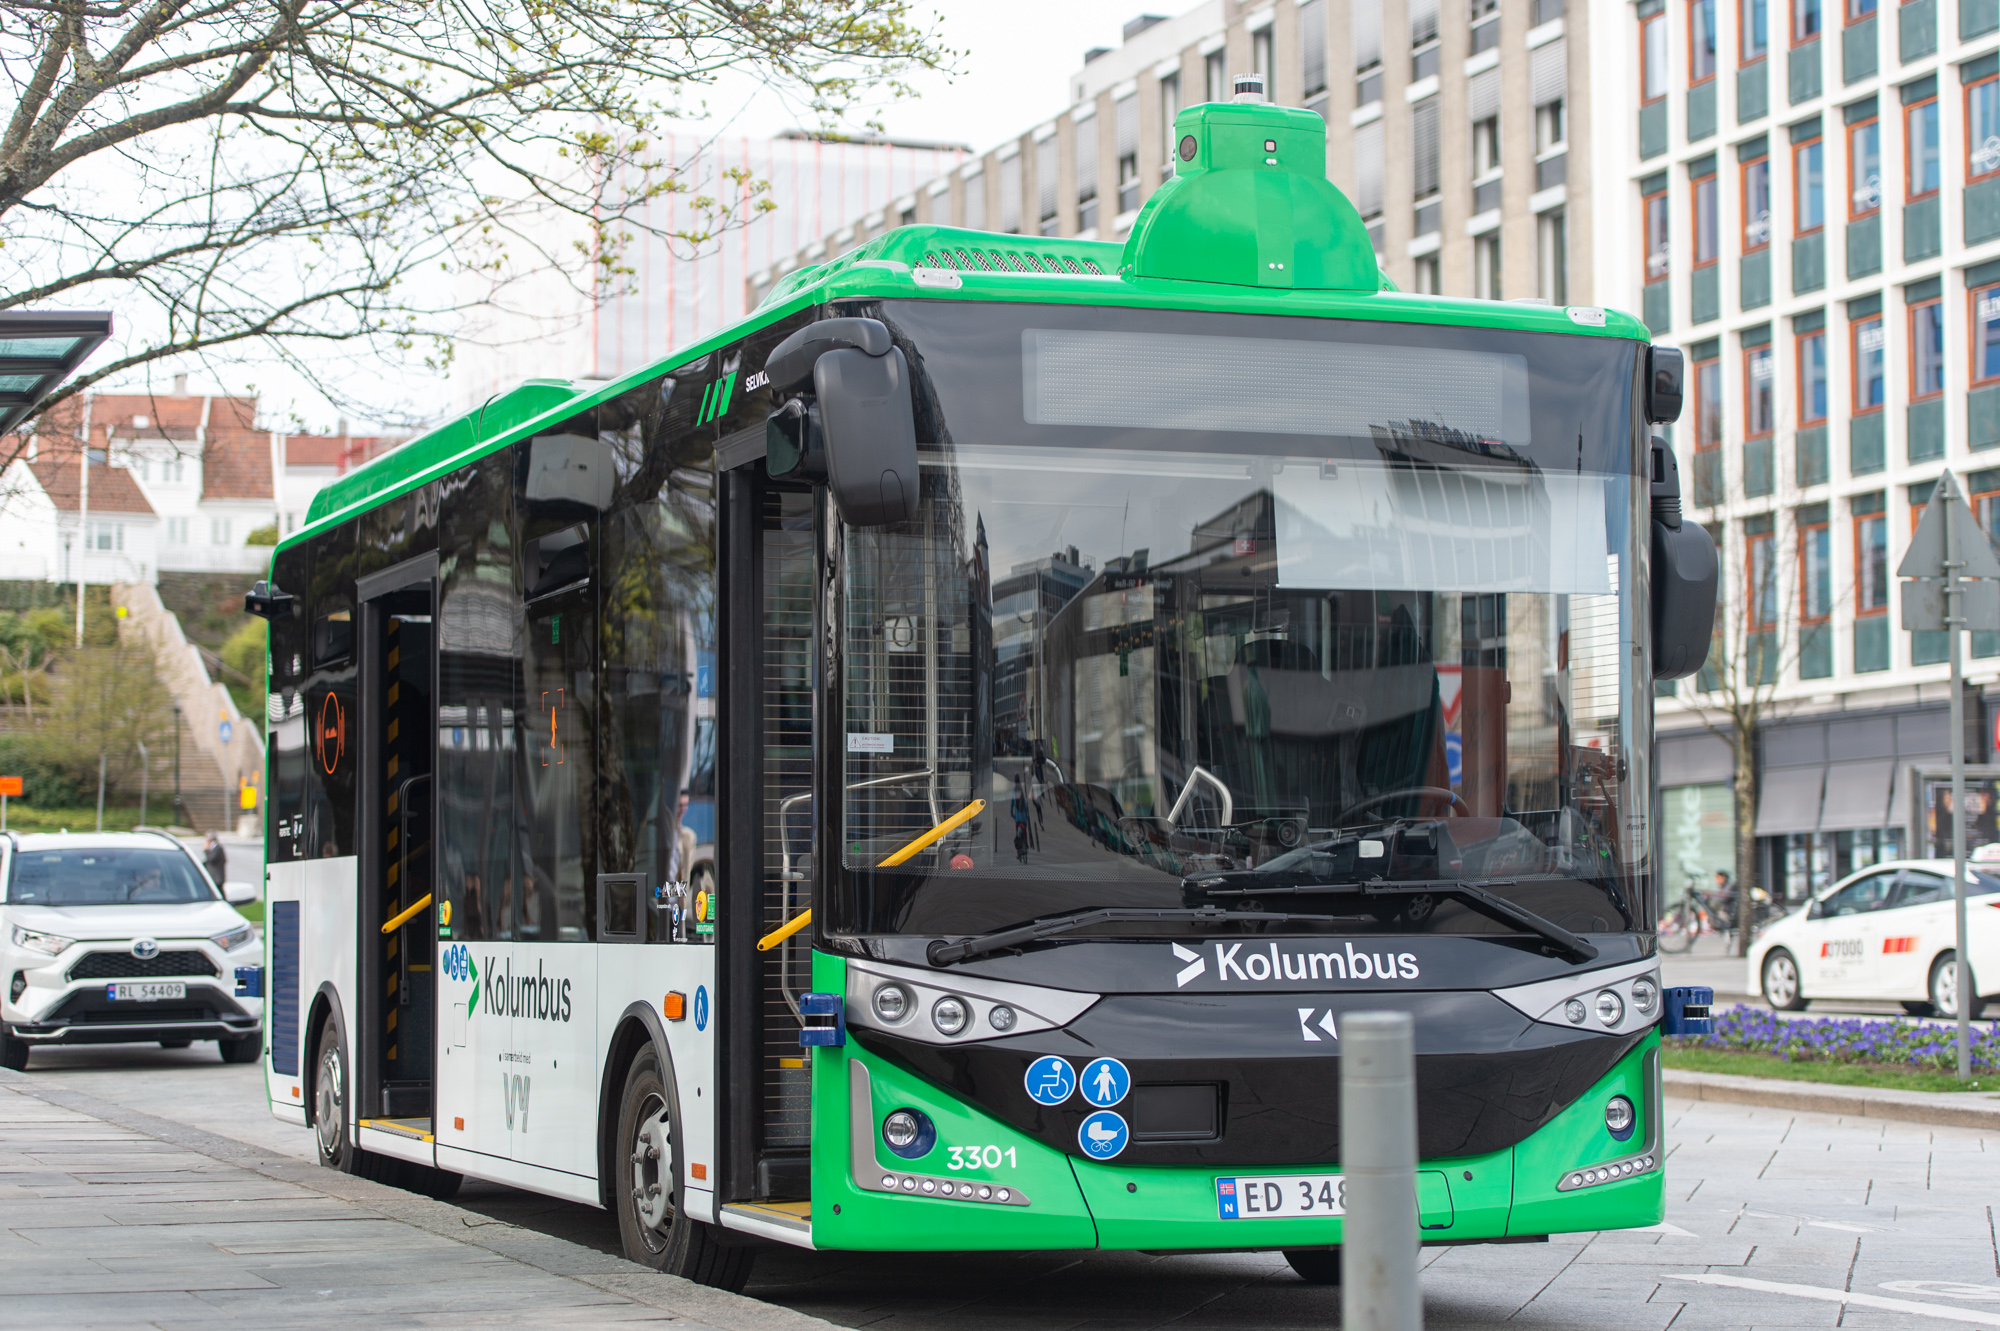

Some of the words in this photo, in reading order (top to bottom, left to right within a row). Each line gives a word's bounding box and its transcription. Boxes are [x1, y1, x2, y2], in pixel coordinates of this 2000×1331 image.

[745, 370, 770, 393] SELVKJ
[1215, 942, 1420, 981] Kolumbus
[119, 986, 134, 998] RL
[141, 984, 182, 998] 54409
[484, 956, 571, 1023] Kolumbus
[946, 1144, 1017, 1171] 3301
[1224, 1203, 1234, 1213] N
[1244, 1182, 1283, 1212] ED
